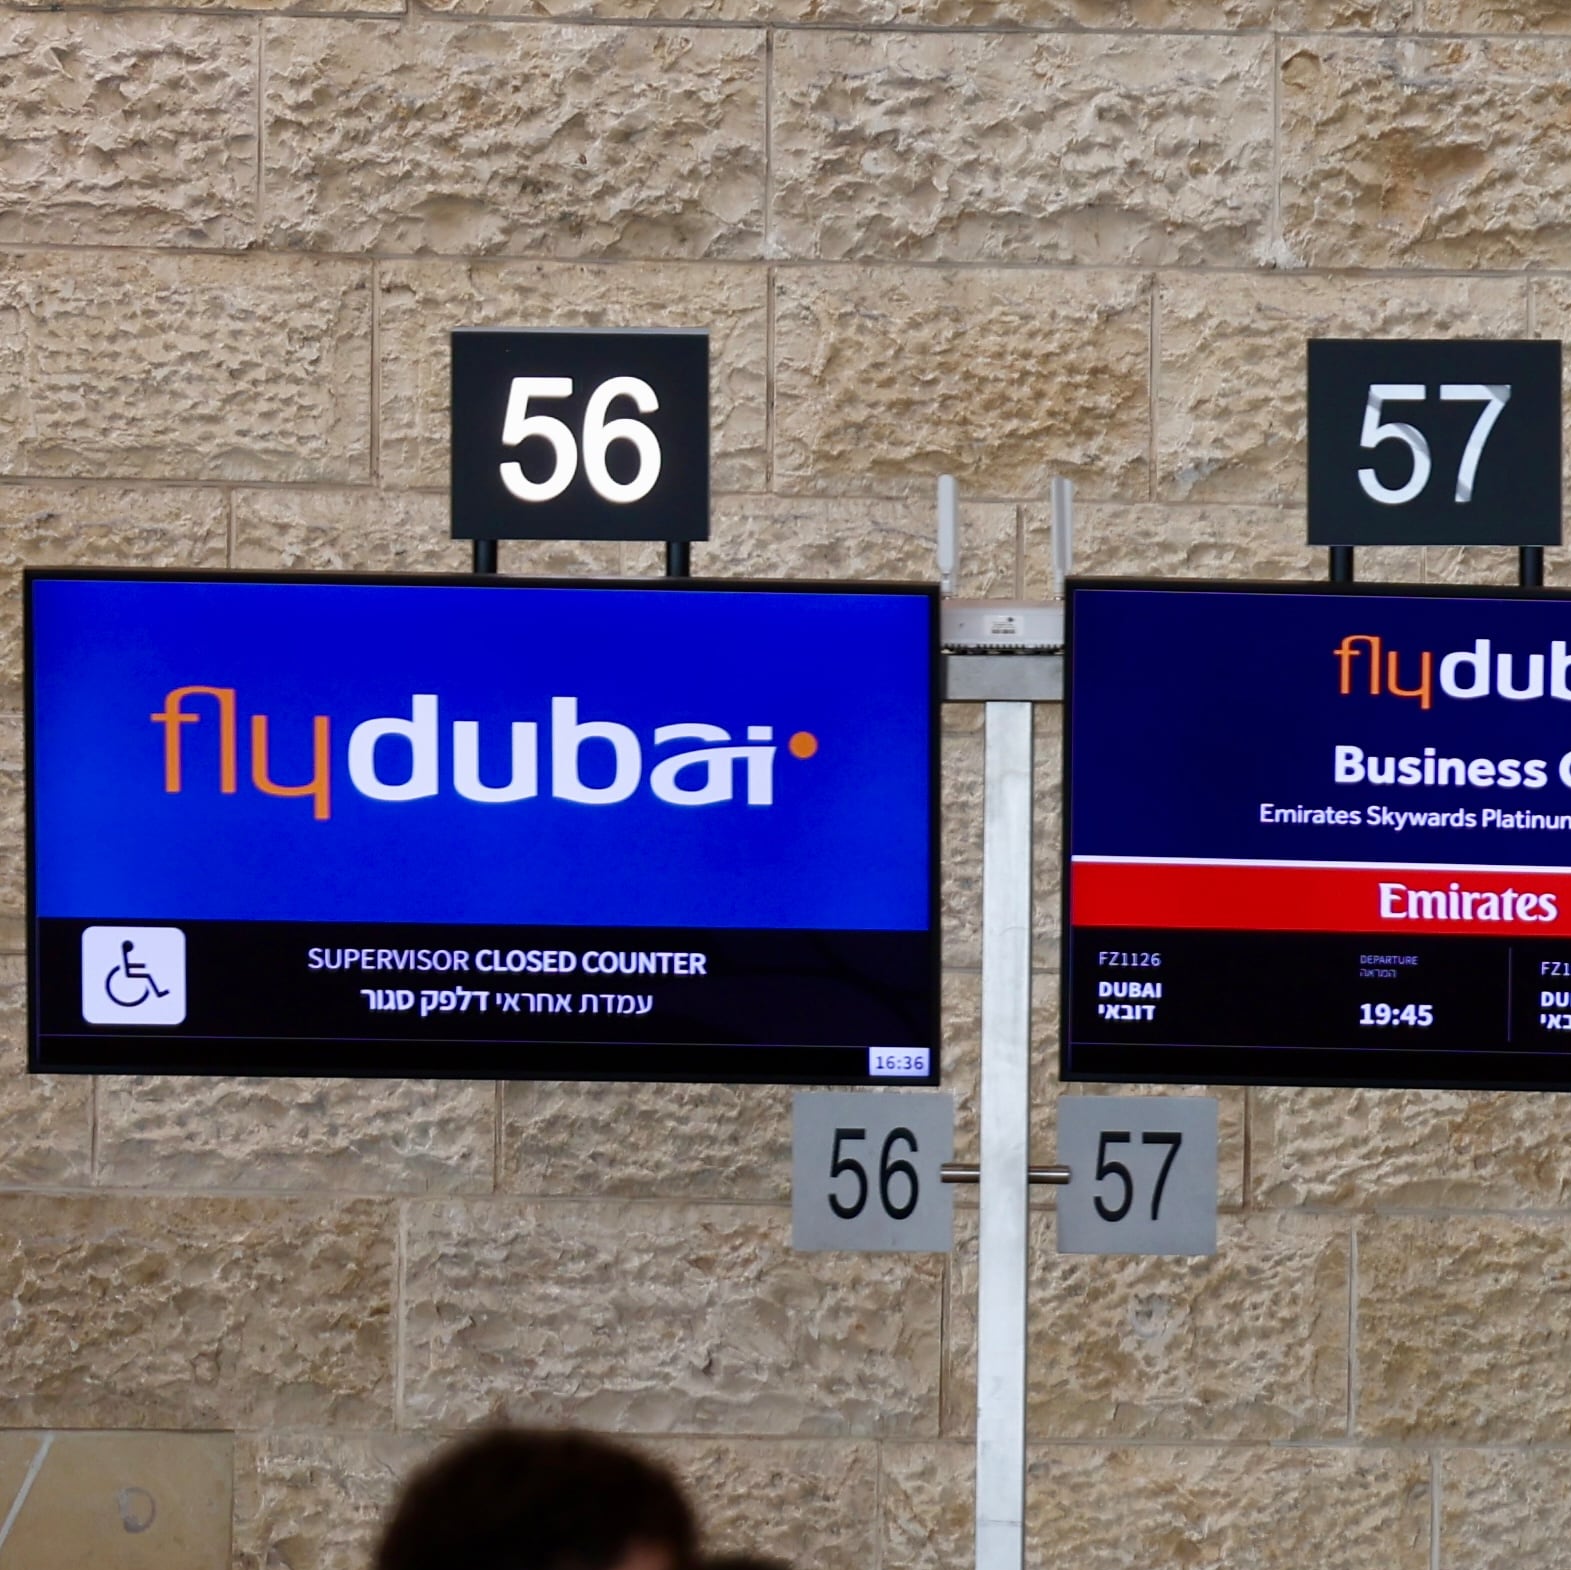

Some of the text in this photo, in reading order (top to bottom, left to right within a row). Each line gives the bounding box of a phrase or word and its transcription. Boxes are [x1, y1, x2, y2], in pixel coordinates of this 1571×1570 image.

[500, 377, 661, 503] 56
[1358, 384, 1510, 504] 57
[151, 686, 818, 820] flydubai
[1335, 746, 1547, 788] Business
[1260, 803, 1362, 824] Emirates
[1367, 806, 1477, 831] Skywards
[1379, 883, 1558, 922] Emirates
[308, 948, 707, 975] SUPERVISOR CLOSED COUNTER
[1099, 952, 1161, 966] FZ1126
[1360, 955, 1418, 965] DEPARTURE
[360, 986, 653, 1017] עמדת אחראי דלפק סגור
[1099, 982, 1162, 998] DUBAI
[1098, 1004, 1155, 1020] דובאי
[1360, 1003, 1433, 1026] 19:45
[877, 1056, 924, 1070] 16:36
[828, 1127, 918, 1220] 56
[1094, 1131, 1182, 1222] 57
